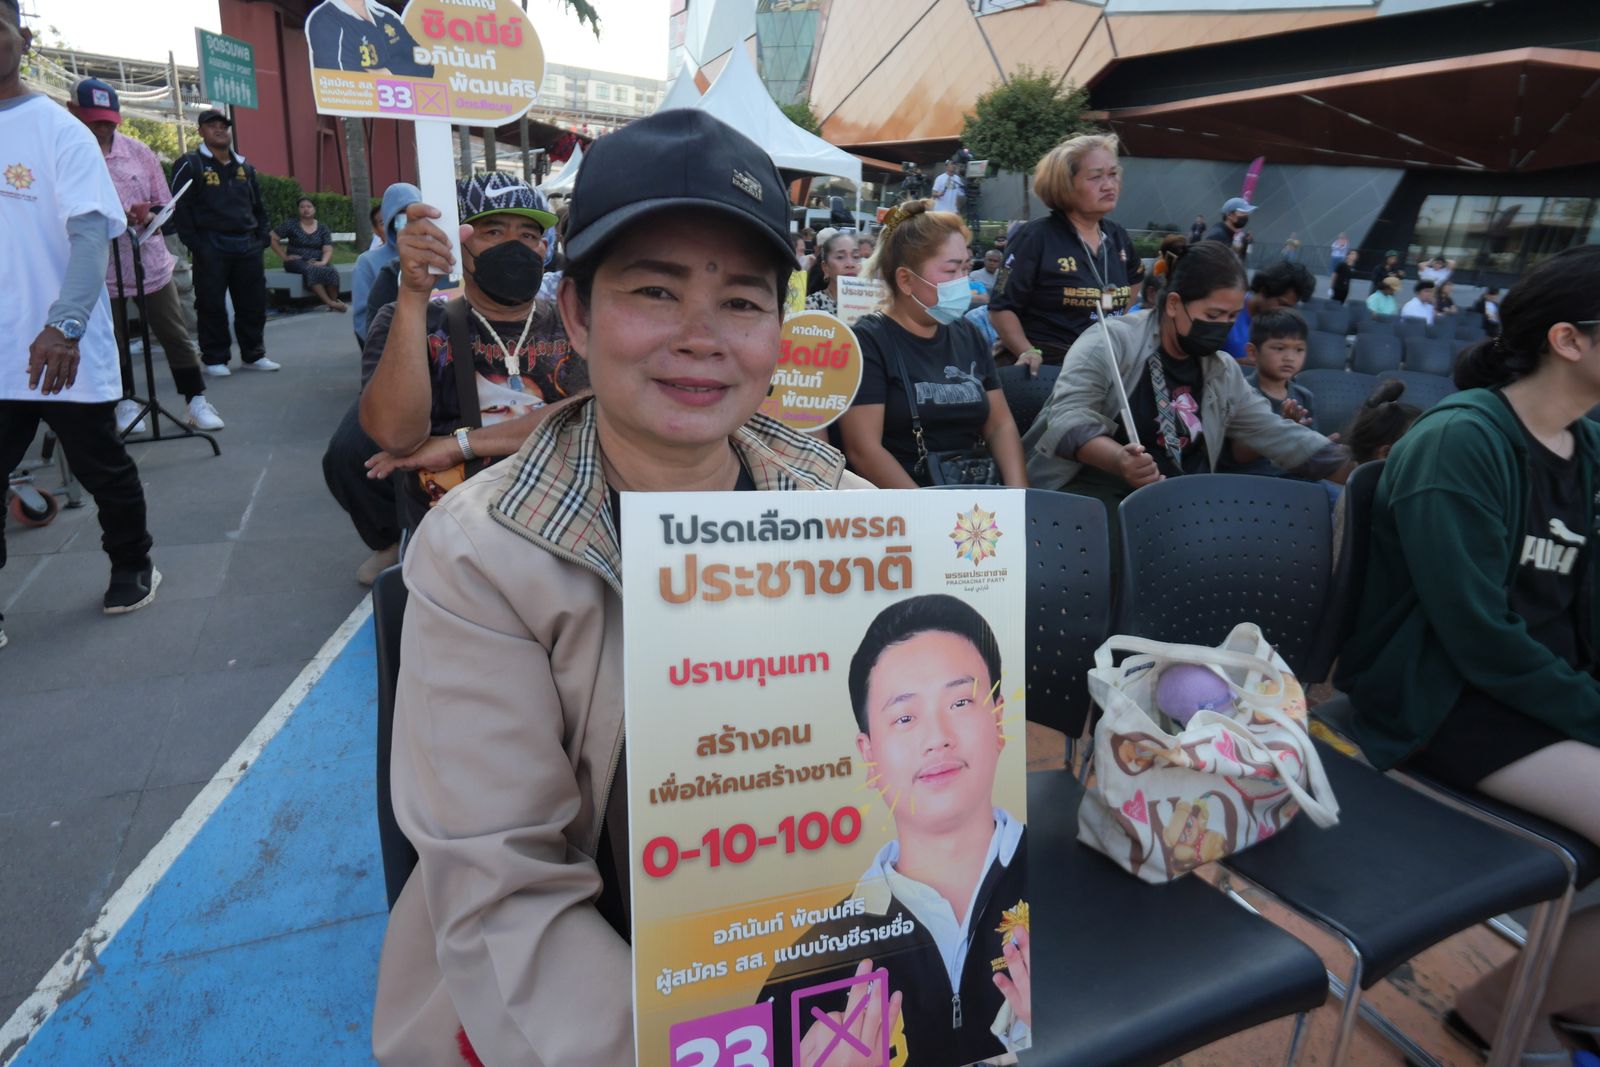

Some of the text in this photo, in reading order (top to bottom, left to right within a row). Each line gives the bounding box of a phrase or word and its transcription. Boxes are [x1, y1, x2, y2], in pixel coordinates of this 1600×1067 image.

[421, 8, 524, 48] ซิดนีย์
[413, 46, 496, 71] อภินันท์
[377, 84, 413, 109] 33
[449, 71, 538, 99] พัฒนศิริ
[1057, 256, 1078, 272] 33
[792, 325, 835, 339] หาดใหญ่
[771, 369, 823, 388] ภินันท์
[914, 381, 982, 405] PUMA
[782, 390, 847, 410] พัฒนศิริ
[659, 509, 906, 545] โปรดเลือกพรรค
[659, 545, 912, 604] ประชาชาติ
[945, 578, 985, 587] PRACHACHAT
[669, 651, 830, 687] ปราบทุนเทา
[696, 723, 812, 757] สร้างคน
[649, 756, 852, 805] เพื่อให้คนสร้างชาติ
[642, 806, 862, 878] 0-10-100
[713, 896, 866, 945] อภินันท์ พัฒนศิริ
[656, 912, 916, 996] ผู้สมัคร สส. แบบบัญชีรายชื่อ
